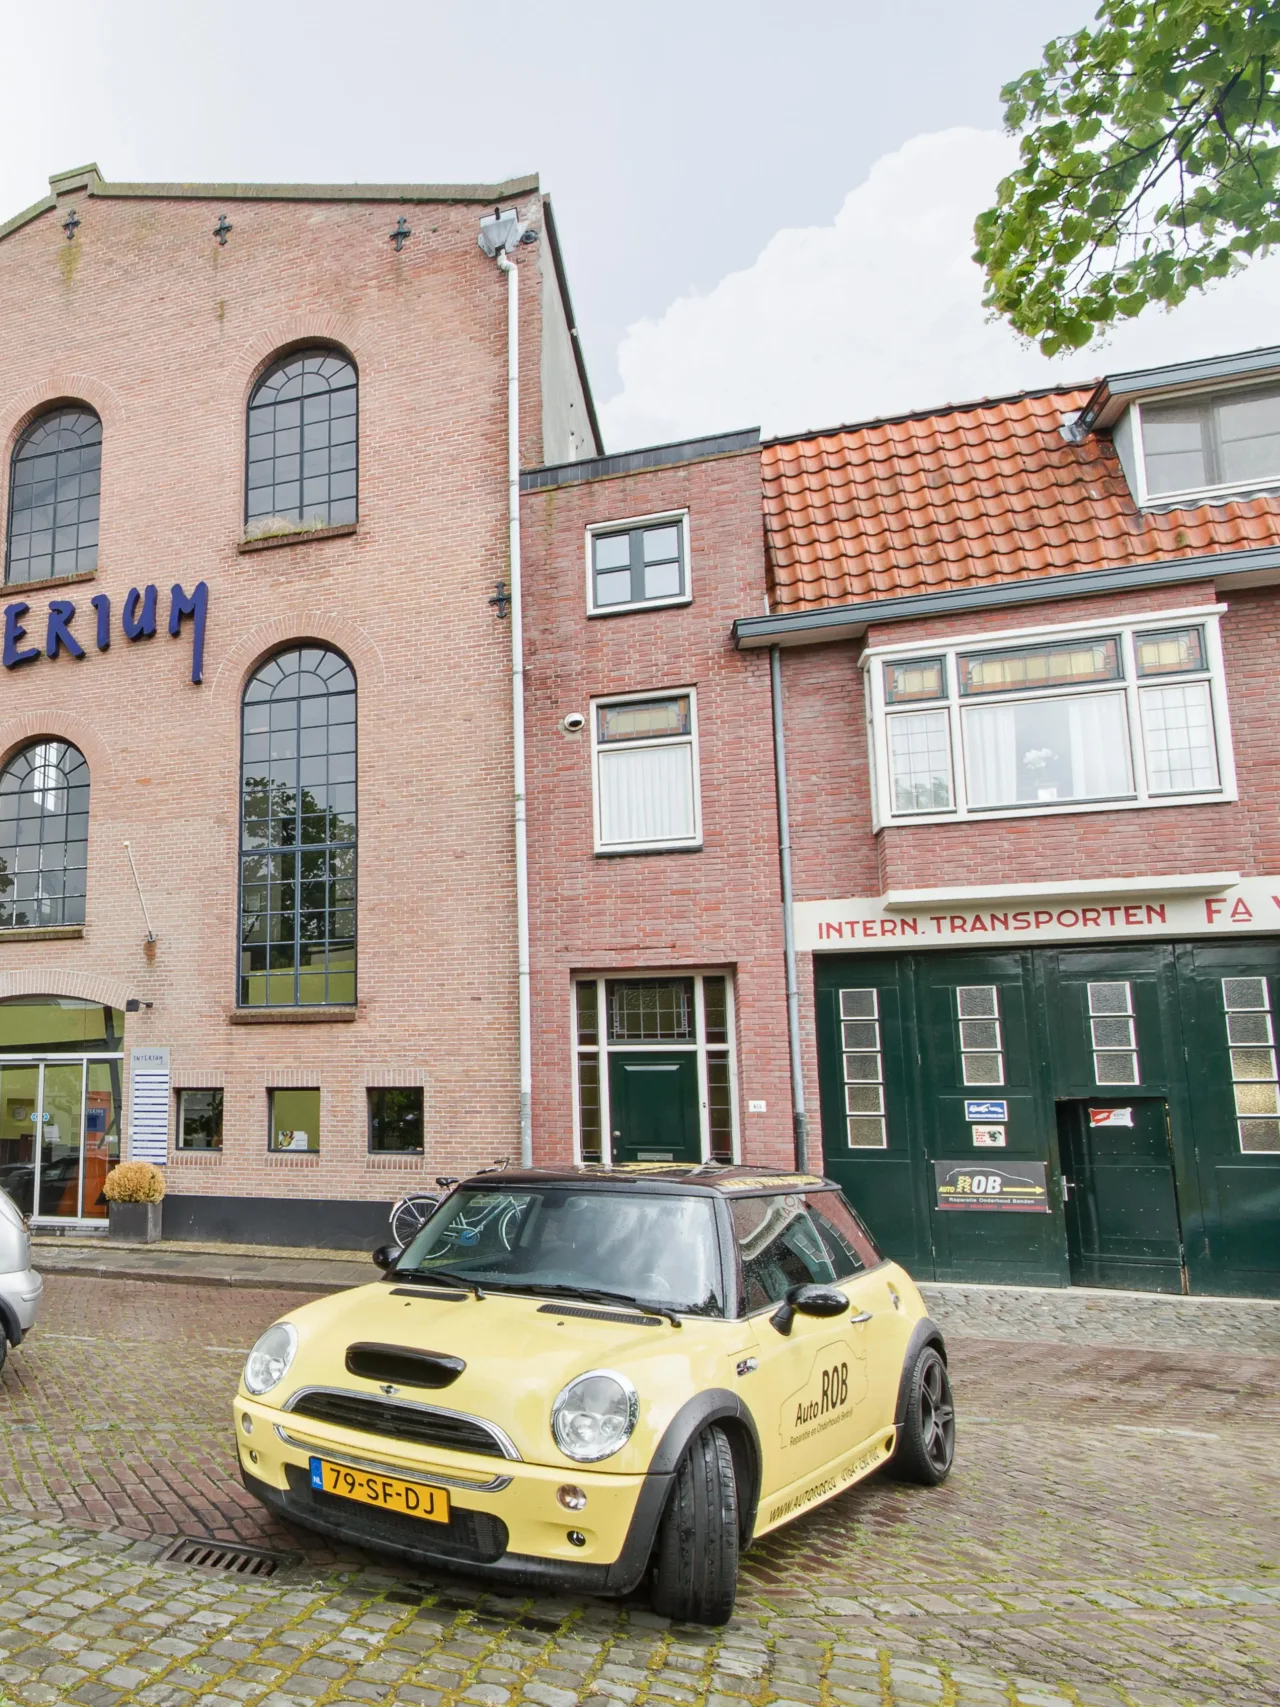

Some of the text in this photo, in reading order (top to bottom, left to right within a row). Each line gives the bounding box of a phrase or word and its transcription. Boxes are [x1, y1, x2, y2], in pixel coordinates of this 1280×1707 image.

[818, 917, 925, 939] INTERN.
[930, 904, 1166, 934] TRANSPORTEN
[1205, 897, 1253, 923] FA
[794, 1362, 848, 1428] Auto ROB
[313, 1476, 322, 1484] NL
[329, 1467, 434, 1515] 79-SF-DJ
